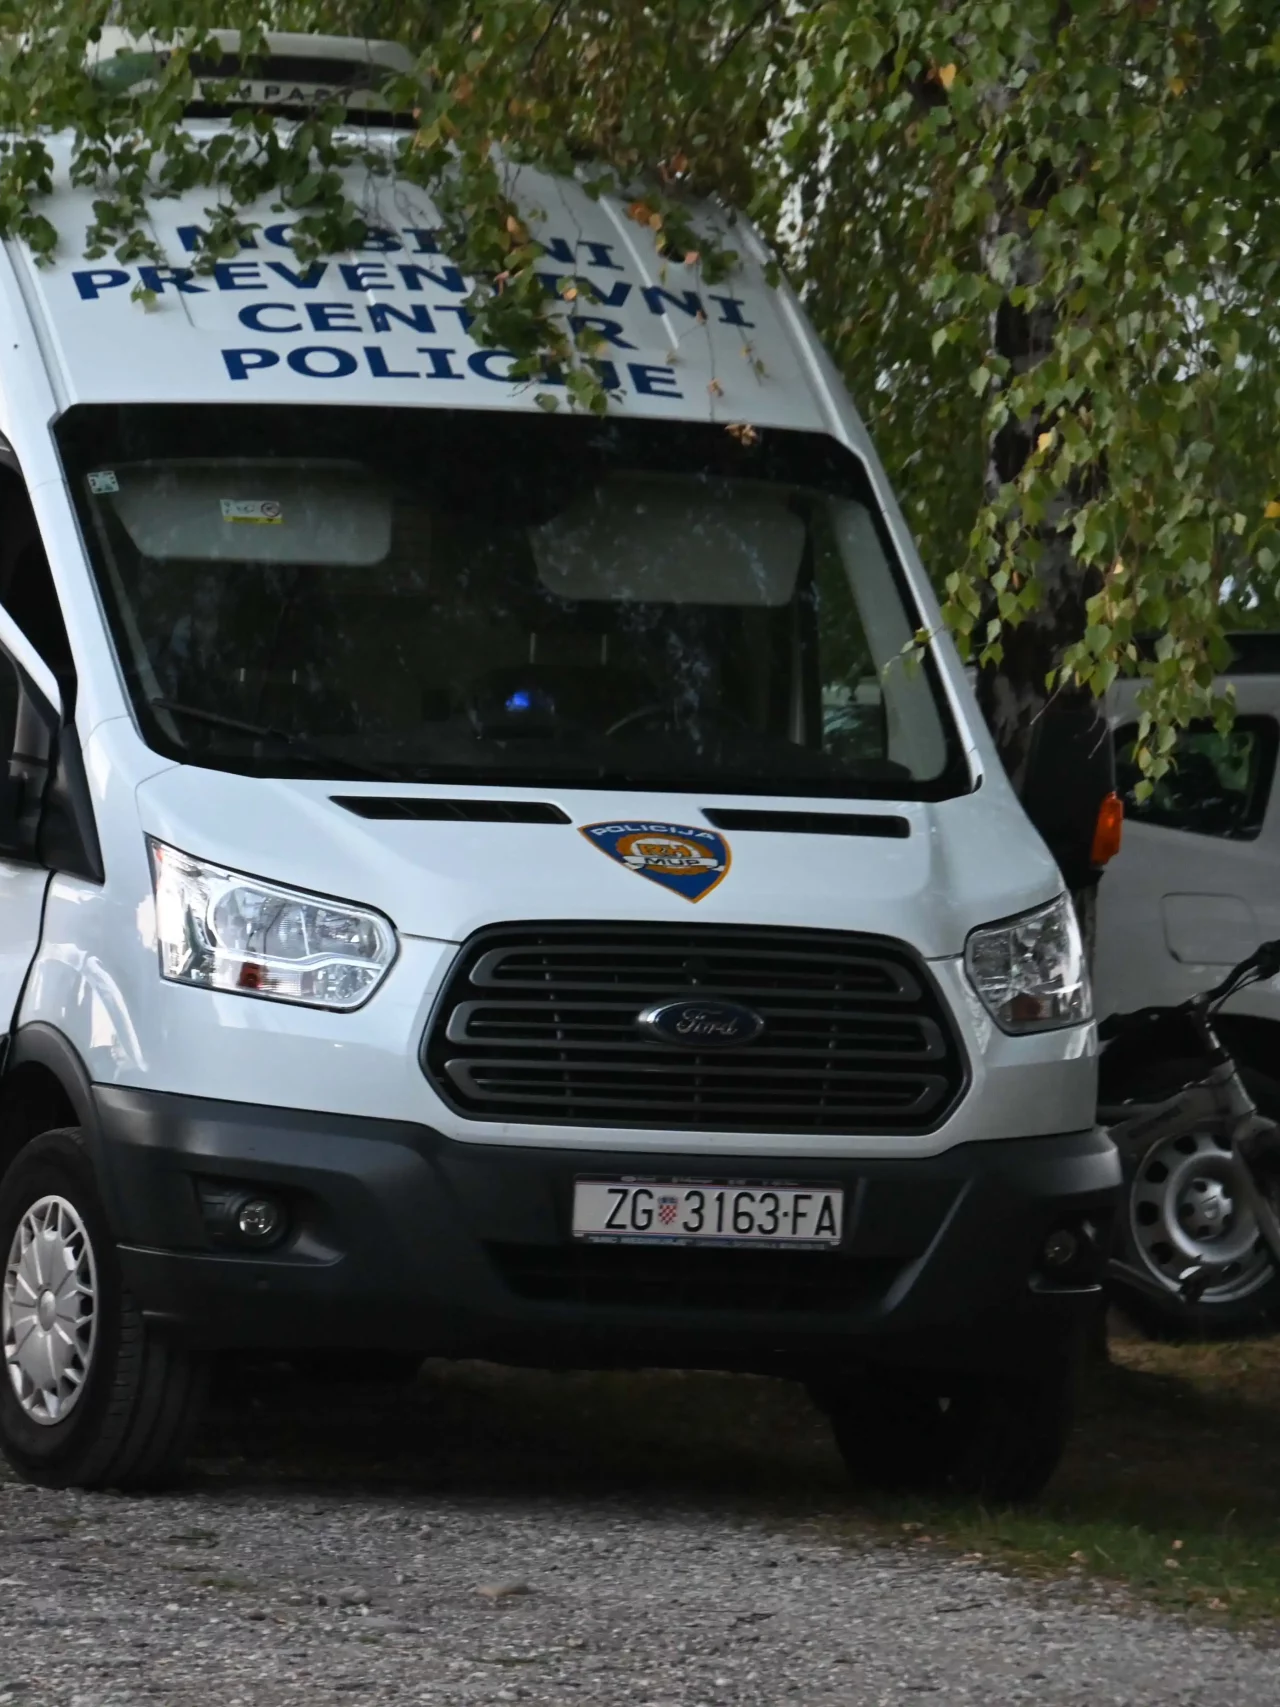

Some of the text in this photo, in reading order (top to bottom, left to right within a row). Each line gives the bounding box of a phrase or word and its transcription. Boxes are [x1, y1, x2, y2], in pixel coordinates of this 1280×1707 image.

[71, 261, 756, 329] PREVENIVNI
[237, 302, 641, 350] CENTR
[589, 824, 716, 841] POLICIJA
[644, 857, 701, 867] MUP
[675, 1007, 738, 1036] Ford
[604, 1187, 655, 1231] ZG
